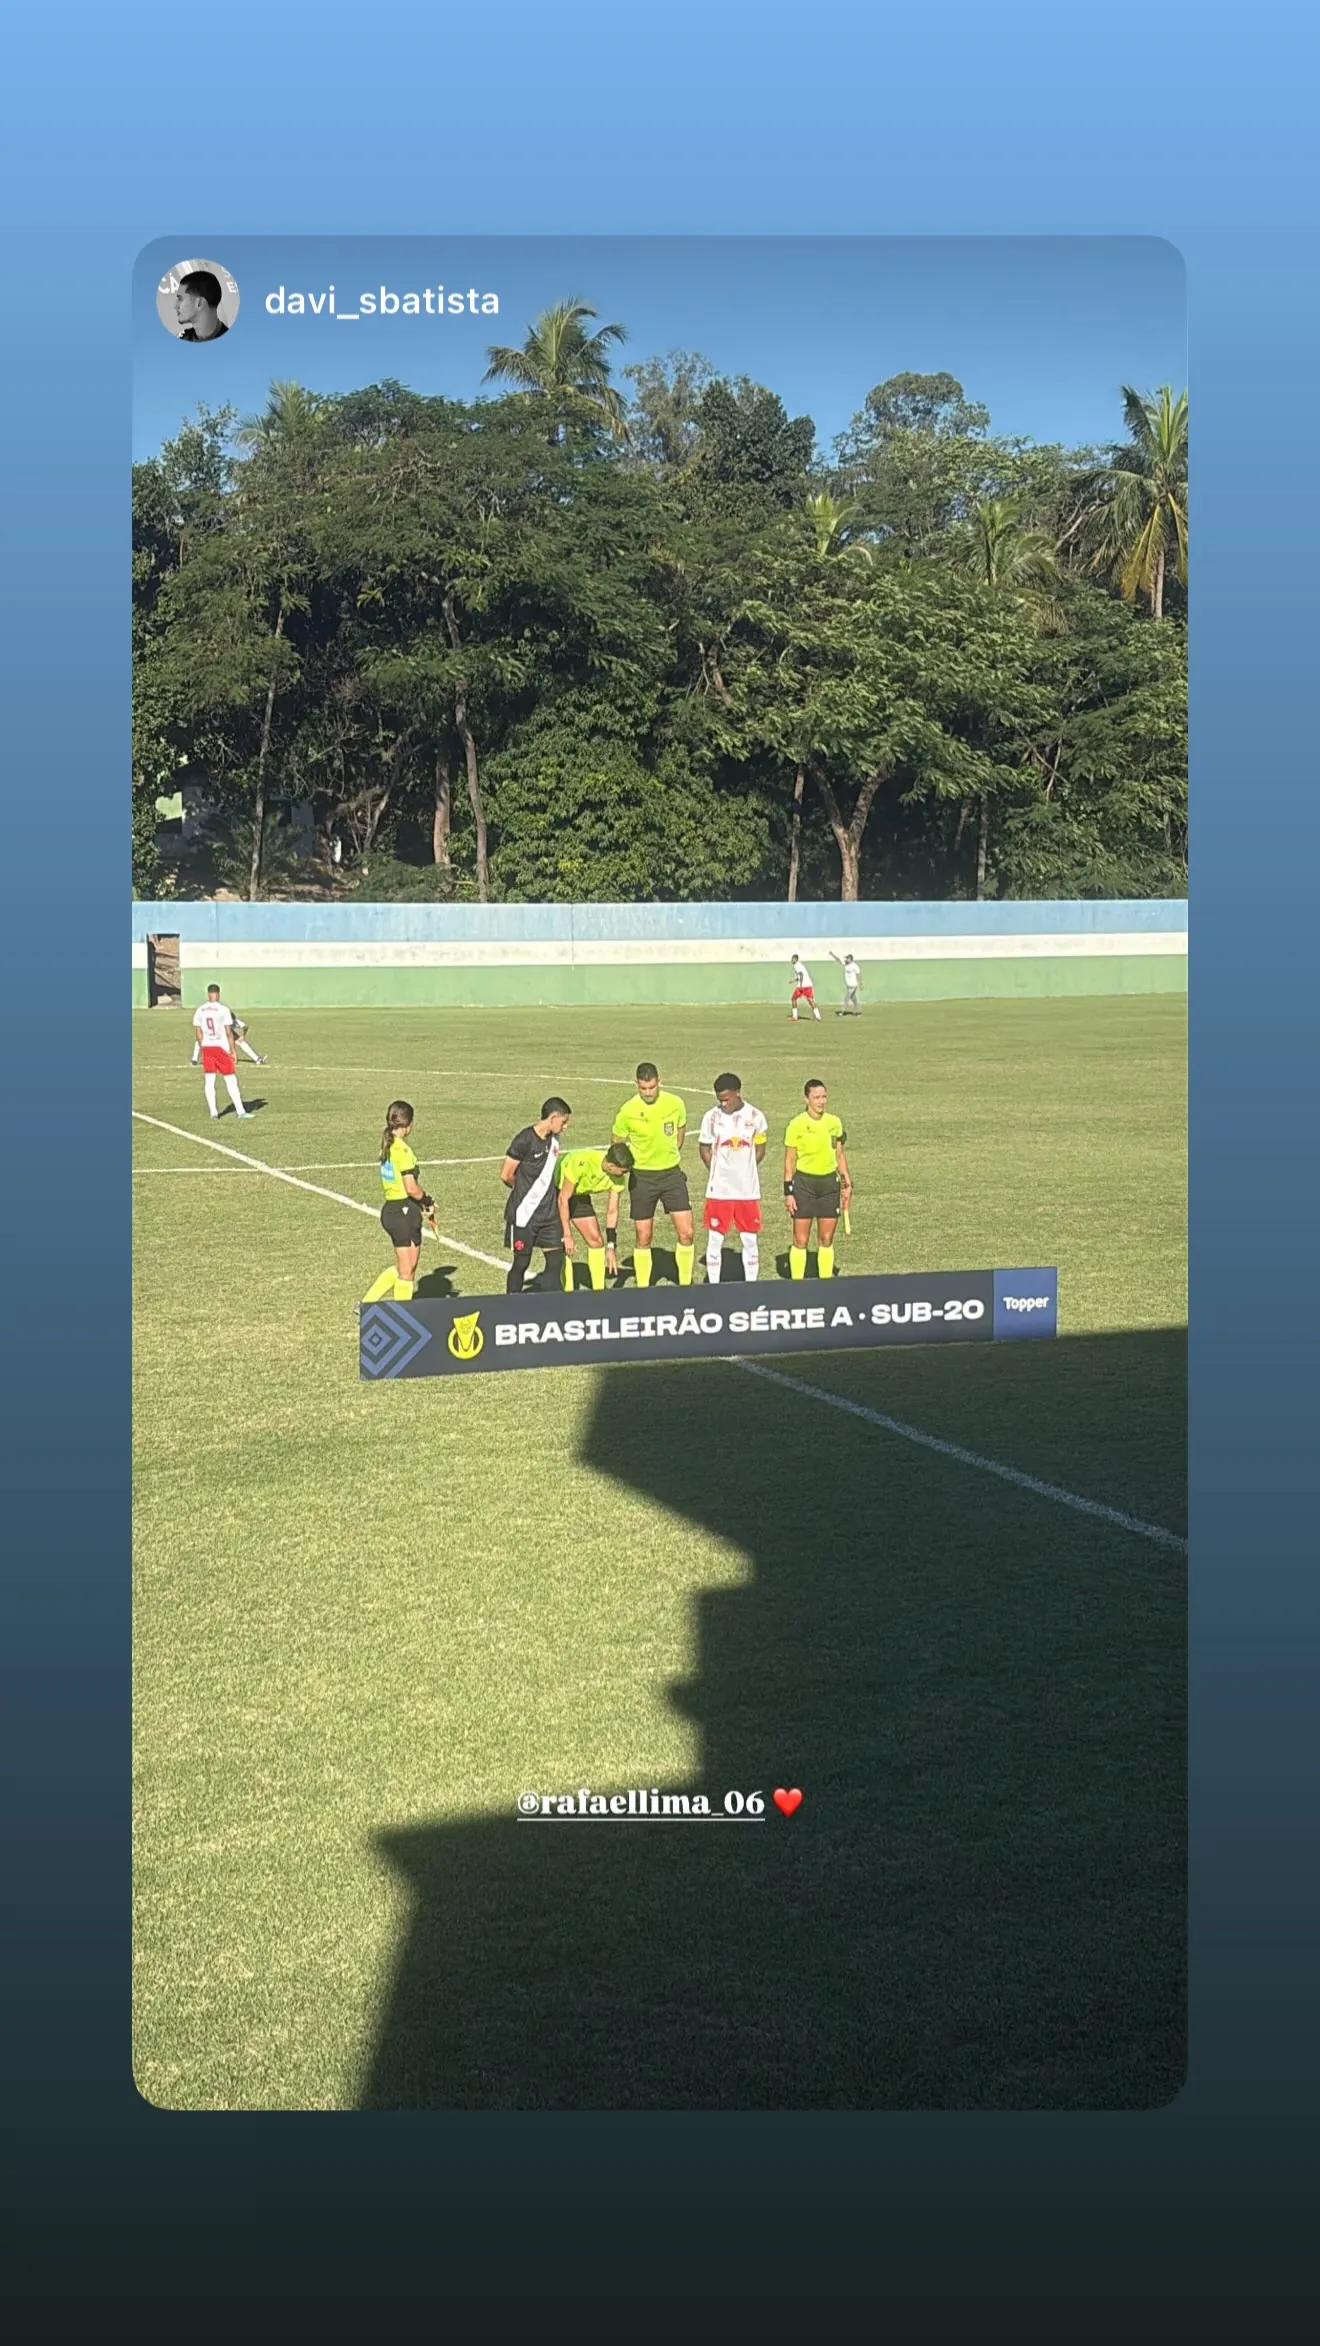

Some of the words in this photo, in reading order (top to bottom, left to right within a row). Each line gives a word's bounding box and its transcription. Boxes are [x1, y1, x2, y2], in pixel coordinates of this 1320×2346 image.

[206, 1017, 216, 1036] 9
[1003, 1296, 1049, 1312] Topper
[495, 1308, 723, 1346] BRASILEIRÃO
[729, 1305, 825, 1333] SÉRIE
[830, 1306, 853, 1327] A
[871, 1299, 985, 1325] SUB-20
